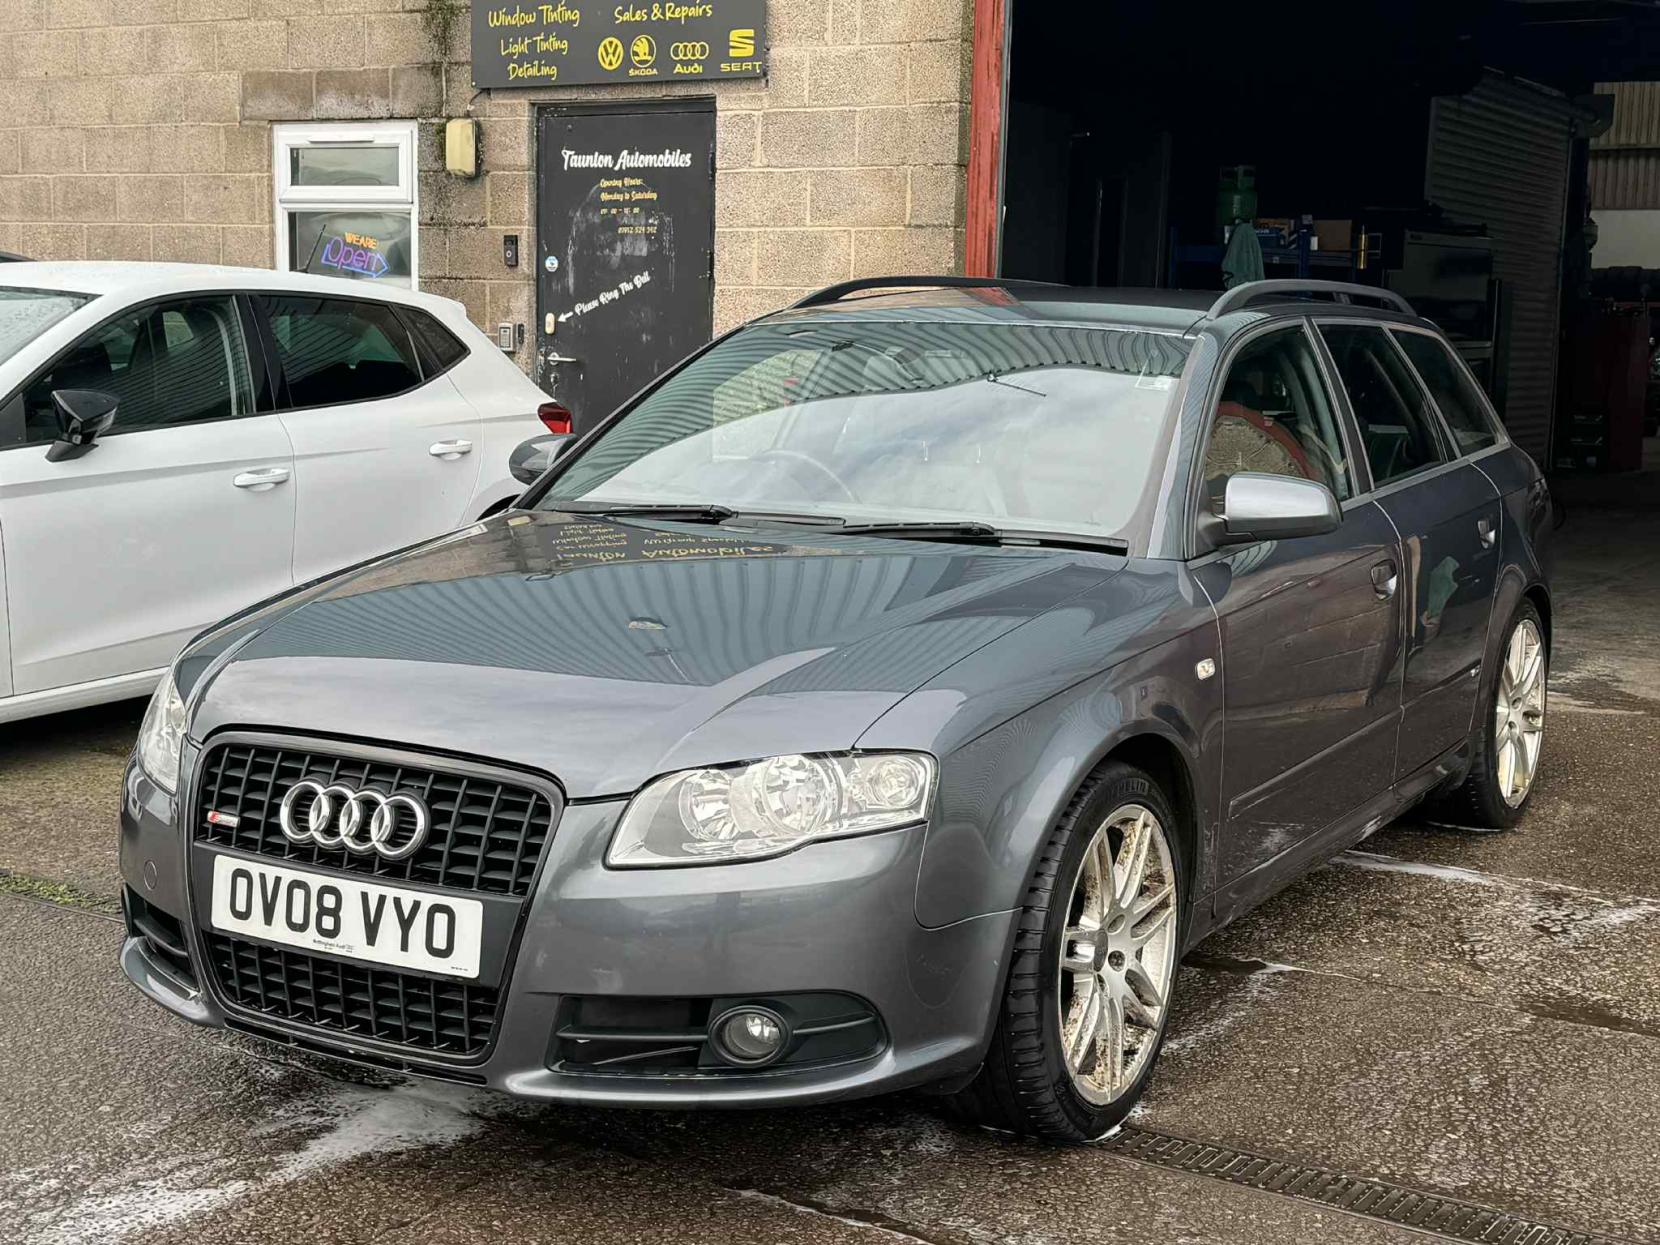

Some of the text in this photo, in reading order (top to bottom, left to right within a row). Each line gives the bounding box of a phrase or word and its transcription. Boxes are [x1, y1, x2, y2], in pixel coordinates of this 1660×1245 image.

[488, 2, 580, 27] Window Tinting
[614, 1, 713, 24] Sales & Repairs
[500, 32, 568, 59] Light Tinting
[507, 60, 557, 80] Detailing
[673, 63, 703, 74] Audi
[720, 62, 763, 73] SEAT
[561, 149, 692, 171] Taunton Automobiles
[328, 236, 378, 270] Open
[574, 271, 651, 316] Please Ring The Bell
[229, 867, 456, 959] OV08 VYO
